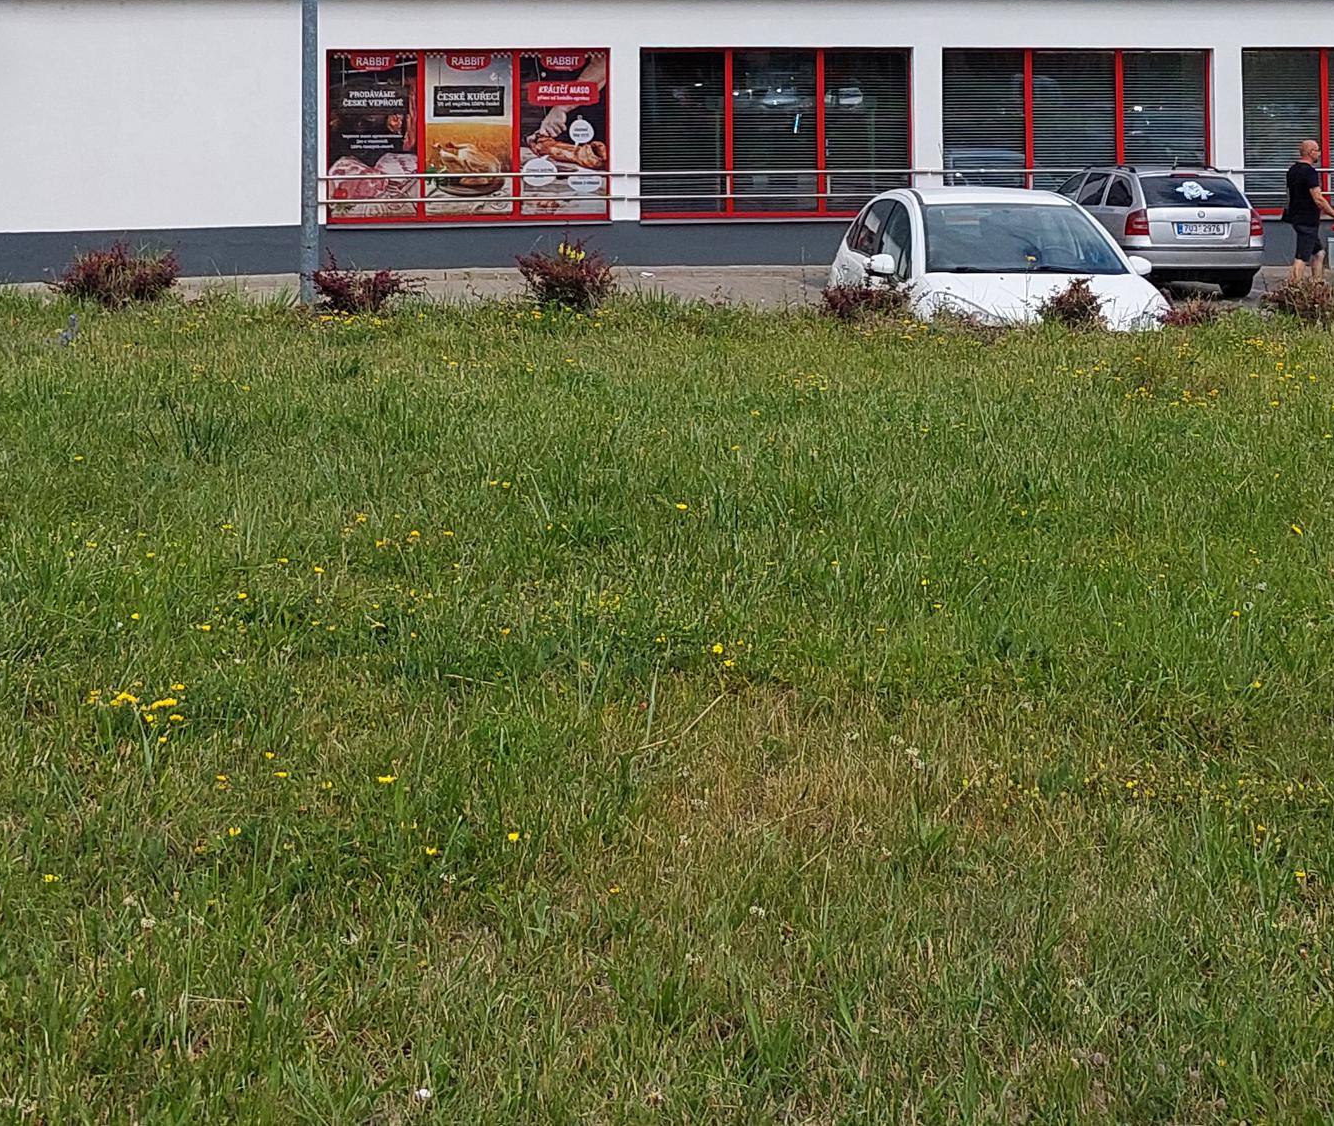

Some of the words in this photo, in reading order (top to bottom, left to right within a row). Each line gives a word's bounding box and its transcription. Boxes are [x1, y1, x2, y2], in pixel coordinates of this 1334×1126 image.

[356, 57, 390, 66] RABBIT
[451, 57, 485, 66] RABBIT
[546, 56, 579, 66] RABBIT
[437, 91, 465, 100] ČESKÉ
[467, 90, 500, 100] KUŘECÍ
